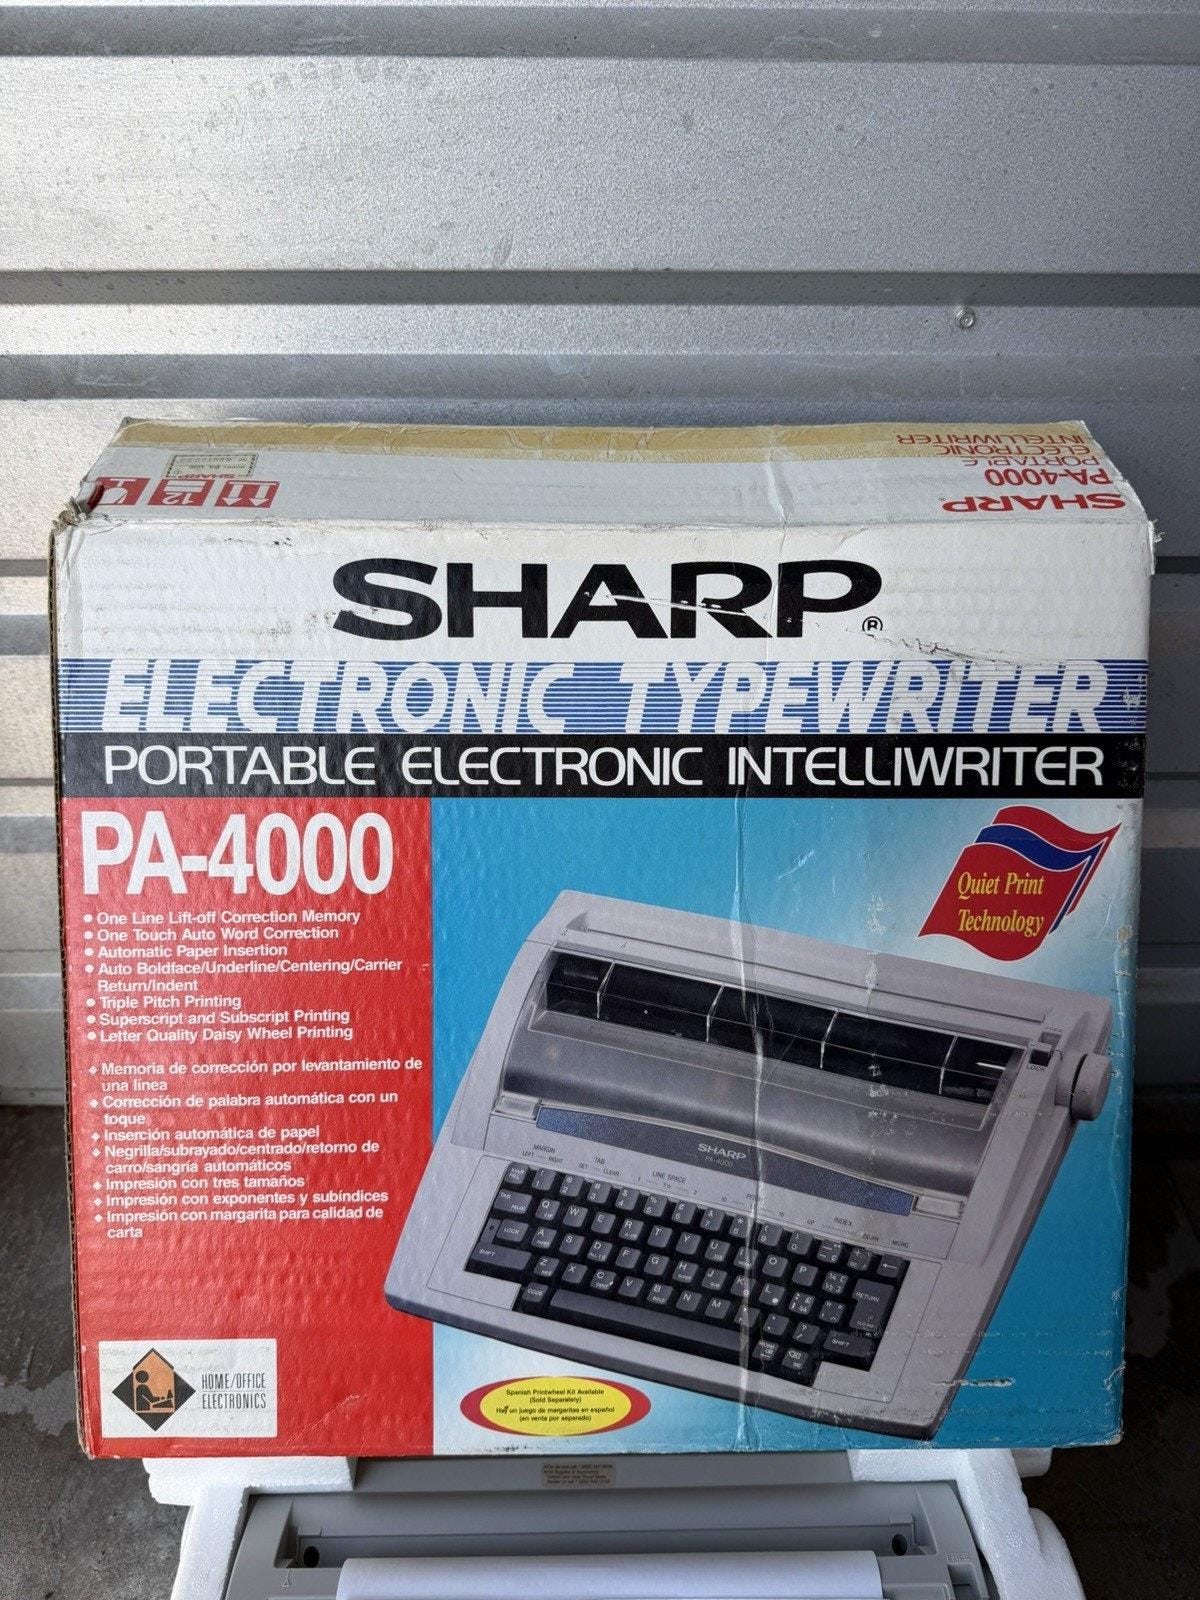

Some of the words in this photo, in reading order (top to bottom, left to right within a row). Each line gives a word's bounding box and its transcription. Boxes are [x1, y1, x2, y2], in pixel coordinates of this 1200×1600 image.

[896, 434, 1085, 444] INTELLIWRITER
[933, 444, 1091, 456] ELECTRONIC
[961, 455, 1100, 466] PORTABLE
[984, 468, 1114, 486] PA-4000
[161, 492, 195, 505] 12
[942, 493, 1126, 512] SHARP
[333, 558, 882, 641] SHARP
[102, 659, 576, 734] ELECTRONIC
[619, 659, 1109, 734] TYPEWRITER
[105, 745, 376, 786] PORTABLE
[401, 746, 702, 786] ELECTRONIC
[728, 746, 1105, 787] INTELLIWRITER
[81, 810, 394, 895] PA-4000
[958, 871, 1000, 900] Quiet
[1004, 871, 1045, 895] Print
[97, 911, 127, 924] One
[132, 911, 164, 924] Line
[169, 910, 216, 924] Lift-off
[221, 910, 297, 923] Correction
[302, 909, 361, 924] Memory
[958, 908, 1045, 937] Technology
[97, 928, 128, 941] One
[133, 928, 176, 941] Touch
[181, 928, 216, 941] Auto
[221, 927, 258, 940] Word
[263, 926, 338, 940] Correction
[98, 945, 172, 958] Automatic
[176, 944, 219, 960] Paper
[223, 943, 287, 957] Insertion
[98, 962, 132, 975] Auto
[137, 958, 402, 975] Boldface/Underline/Centering/Carrier
[97, 979, 198, 992] Return/Indent
[100, 996, 138, 1011] Triple
[143, 995, 180, 1008] Pitch
[184, 995, 241, 1010] Printing
[100, 1012, 183, 1028] Superscript
[188, 1011, 215, 1024] and
[220, 1010, 289, 1026] Subscript
[294, 1008, 350, 1024] Printing
[100, 1029, 142, 1042] Letter
[146, 1028, 198, 1044] Quality
[202, 1027, 242, 1043] Daisy
[247, 1026, 292, 1039] Wheel
[297, 1025, 353, 1040] Printing
[101, 1062, 165, 1075] Memoria
[169, 1062, 187, 1074] de
[191, 1060, 267, 1073] corrección
[272, 1062, 297, 1075] por
[302, 1058, 400, 1071] levantamiento
[405, 1057, 422, 1070] de
[102, 1080, 128, 1092] una
[103, 1094, 181, 1108] Corrección
[186, 1094, 204, 1107] de
[208, 1094, 260, 1110] palabra
[265, 1091, 344, 1105] automática
[348, 1093, 375, 1103] con
[380, 1092, 398, 1102] un
[104, 1114, 145, 1127] toque
[104, 1128, 170, 1141] Inserción
[175, 1126, 254, 1139] automática
[258, 1126, 276, 1138] de
[280, 1125, 319, 1141] papel
[105, 1142, 357, 1160] Negrilla/subrayado/centrado/retorno
[361, 1140, 380, 1152] de
[698, 1143, 746, 1160] SHARP
[105, 1160, 198, 1175] carro/sangría
[204, 1158, 291, 1172] automáticos
[106, 1177, 177, 1192] Impresión
[181, 1178, 208, 1189] con
[213, 1176, 239, 1188] tres
[243, 1174, 304, 1188] tamaños
[106, 1194, 177, 1208] Impresión
[182, 1193, 208, 1204] con
[213, 1192, 295, 1206] exponentes
[299, 1193, 307, 1206] y
[312, 1189, 389, 1202] subíndices
[107, 1211, 178, 1225] Impresión
[180, 1210, 207, 1221] con
[210, 1208, 276, 1223] margarita
[279, 1210, 309, 1222] para
[313, 1206, 362, 1219] calidad
[366, 1205, 383, 1218] de
[107, 1226, 143, 1238] carta
[856, 1290, 880, 1302] RETURN
[831, 1337, 850, 1347] SHIFT
[201, 1372, 267, 1390] HOME/OFFICE
[202, 1393, 267, 1409] ELECTRONICS
[506, 1389, 531, 1397] Spanish
[547, 1396, 582, 1404] Separately)
[519, 1407, 537, 1415] juego
[538, 1406, 546, 1414] de
[549, 1415, 560, 1423] por
